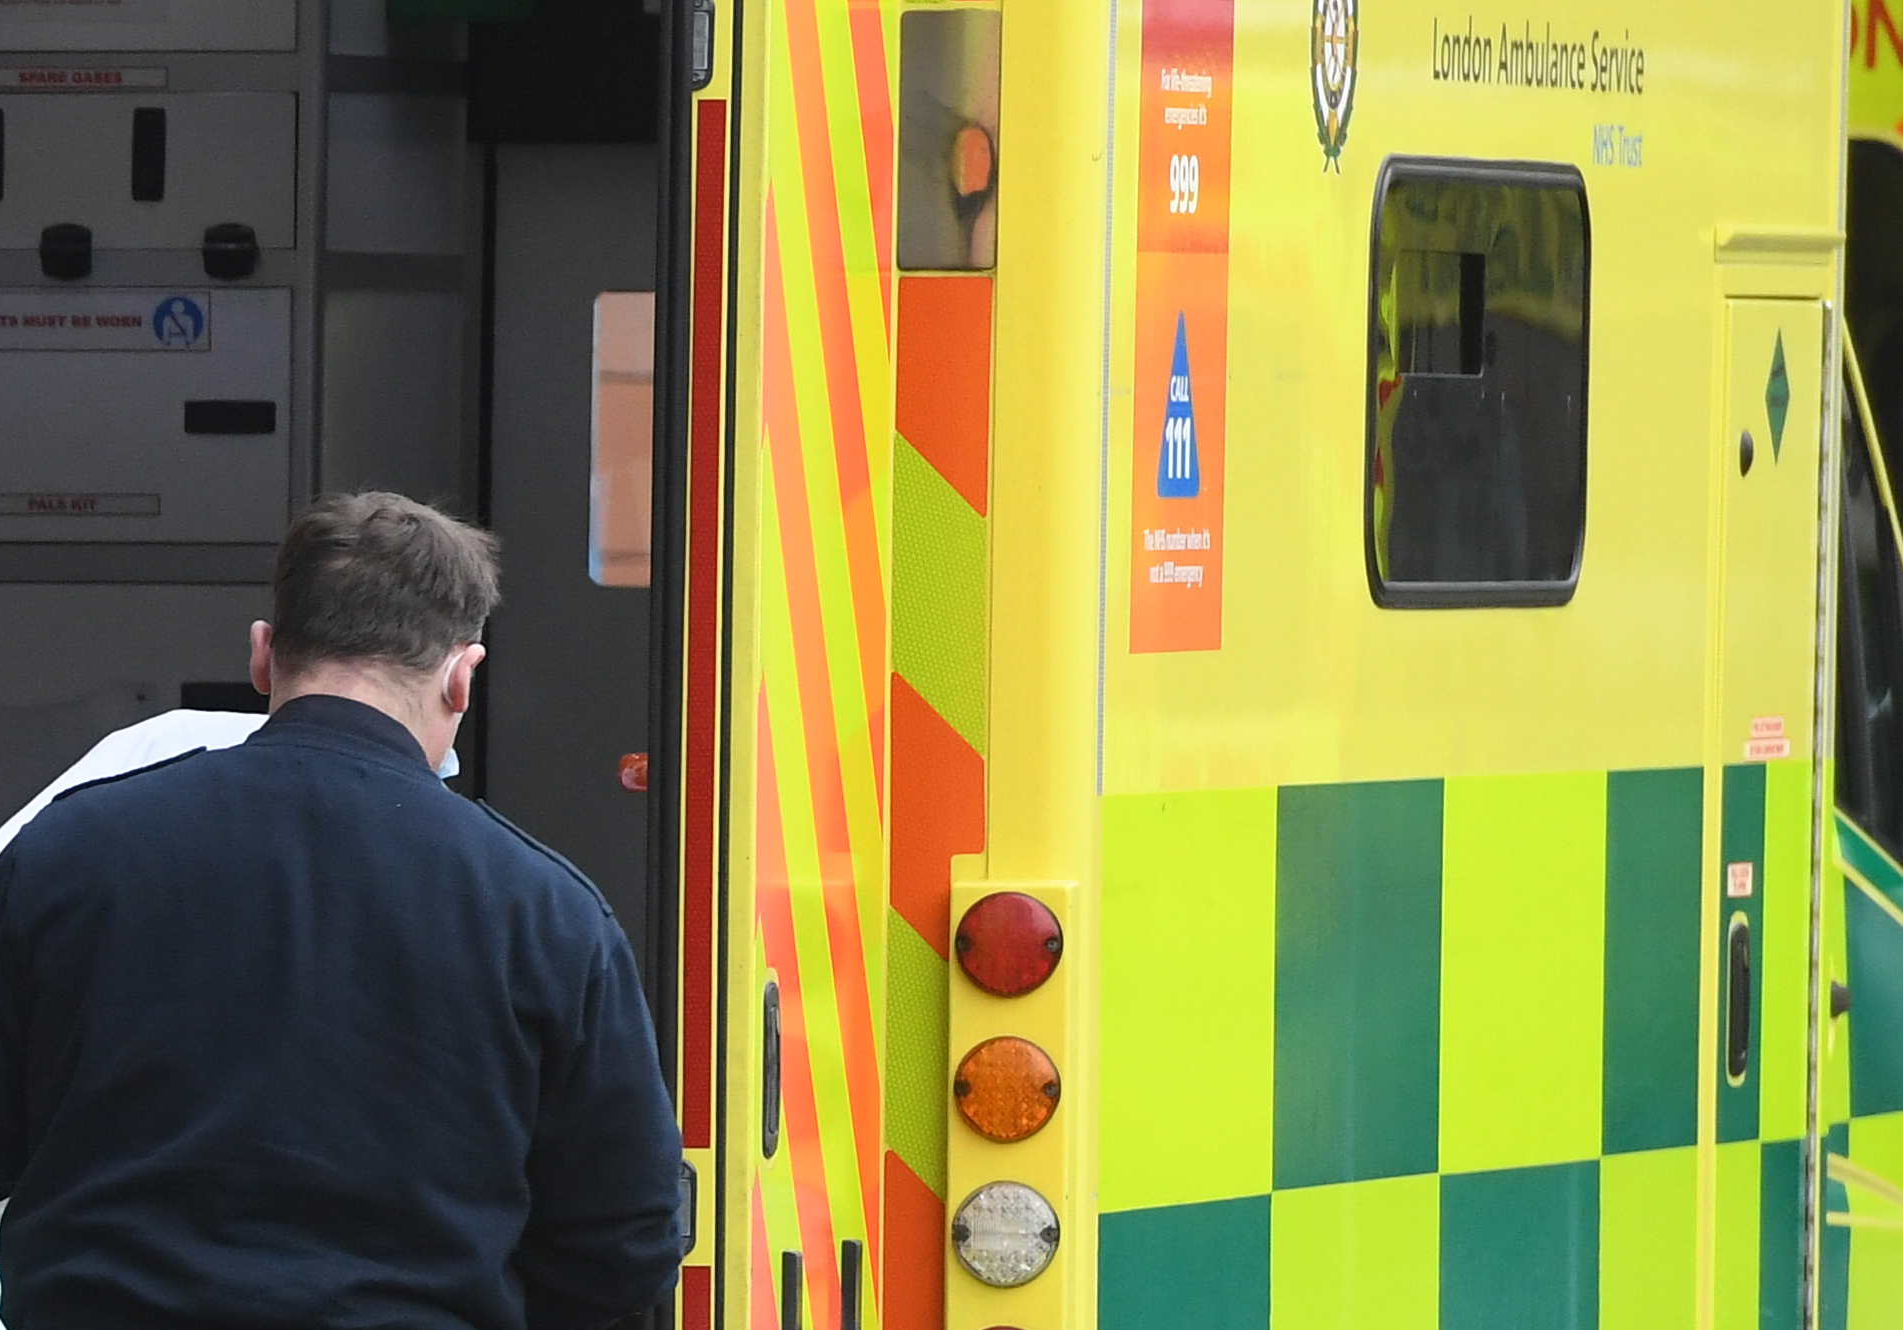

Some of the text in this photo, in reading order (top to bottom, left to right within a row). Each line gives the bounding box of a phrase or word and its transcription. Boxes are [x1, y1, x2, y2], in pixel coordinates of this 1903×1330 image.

[1432, 14, 1645, 95] London Ambulance Service
[1592, 124, 1643, 168] NHS Trust
[1169, 154, 1199, 214] 999
[23, 315, 66, 327] MUST
[71, 315, 91, 327] BE
[96, 315, 142, 327] WORN
[1170, 375, 1189, 402] CALL
[1165, 417, 1191, 480] 111
[1144, 528, 1154, 550] The
[1154, 529, 1166, 550] NHS
[1166, 527, 1186, 550] number
[1187, 528, 1202, 550] when
